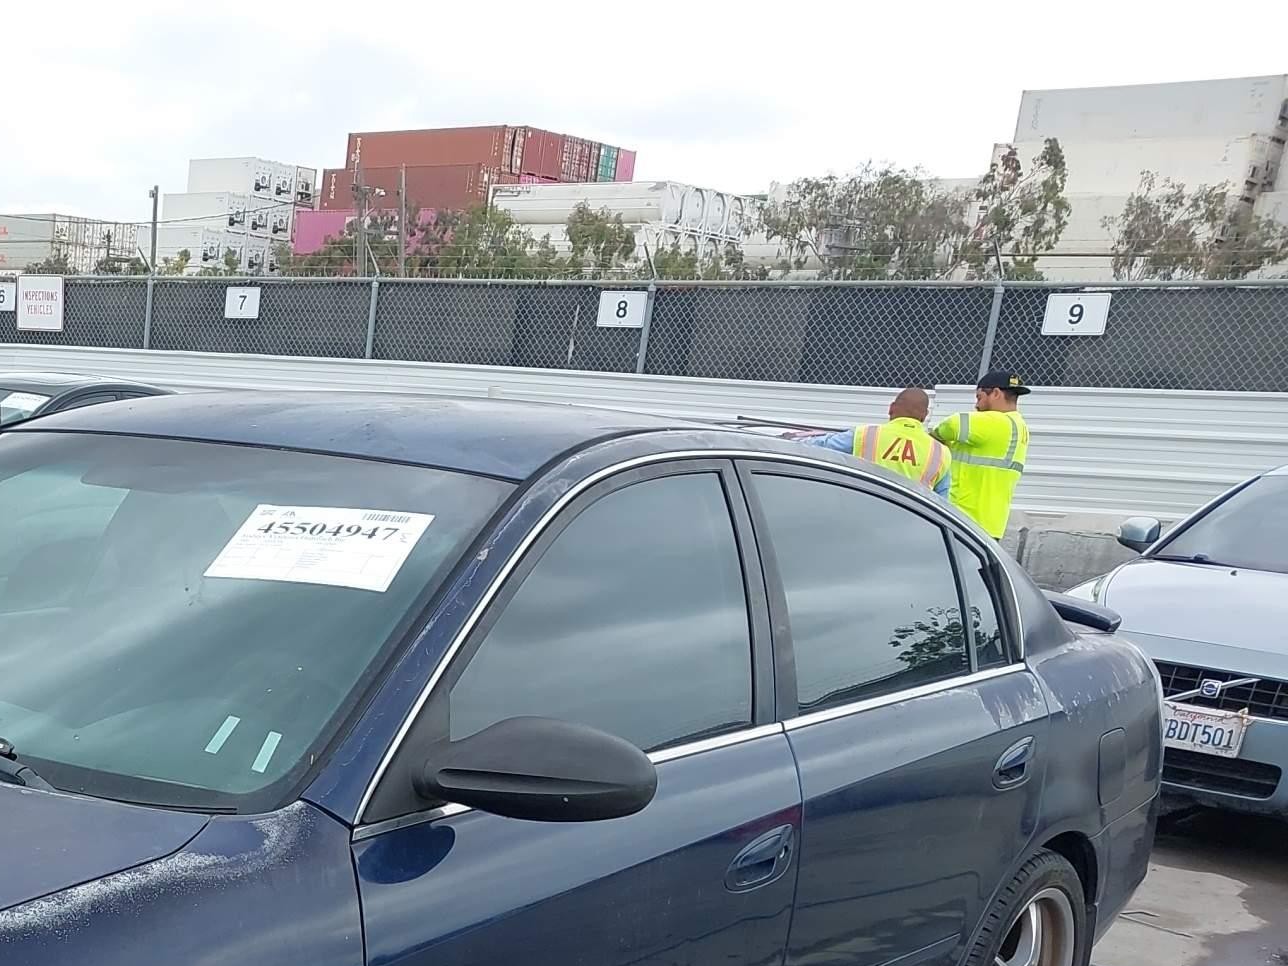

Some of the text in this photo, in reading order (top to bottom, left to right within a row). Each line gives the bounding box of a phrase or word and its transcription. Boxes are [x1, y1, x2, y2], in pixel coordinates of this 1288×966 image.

[22, 290, 58, 302] INSPECTIONS
[239, 295, 248, 310] 7
[26, 303, 53, 315] VEHICLES
[616, 300, 628, 318] 8
[1068, 303, 1084, 325] 9
[257, 521, 400, 541] 45504947
[1164, 718, 1234, 749] BDT501
